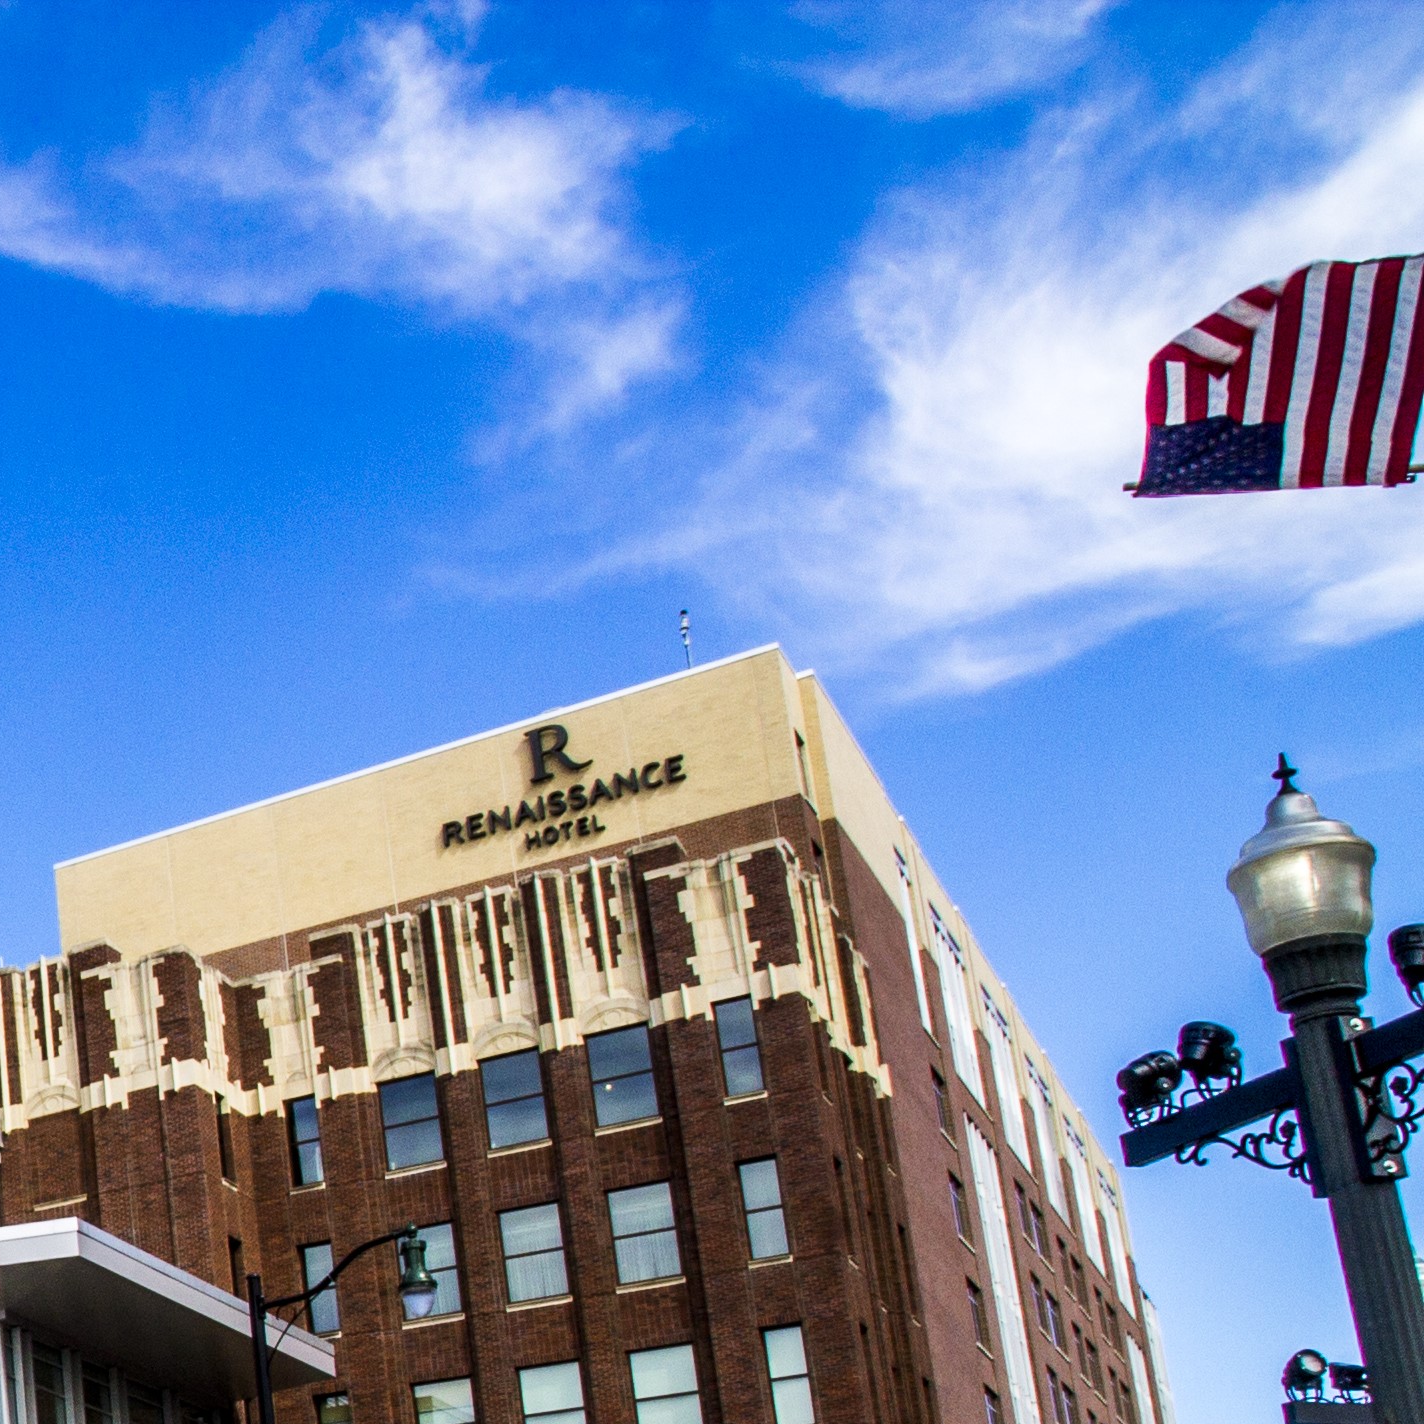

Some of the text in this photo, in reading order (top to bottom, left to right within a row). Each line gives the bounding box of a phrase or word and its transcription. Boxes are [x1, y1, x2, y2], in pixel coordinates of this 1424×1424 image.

[522, 723, 594, 785] R
[440, 753, 688, 849] RENAISSANCE
[524, 813, 606, 851] HOTEL
